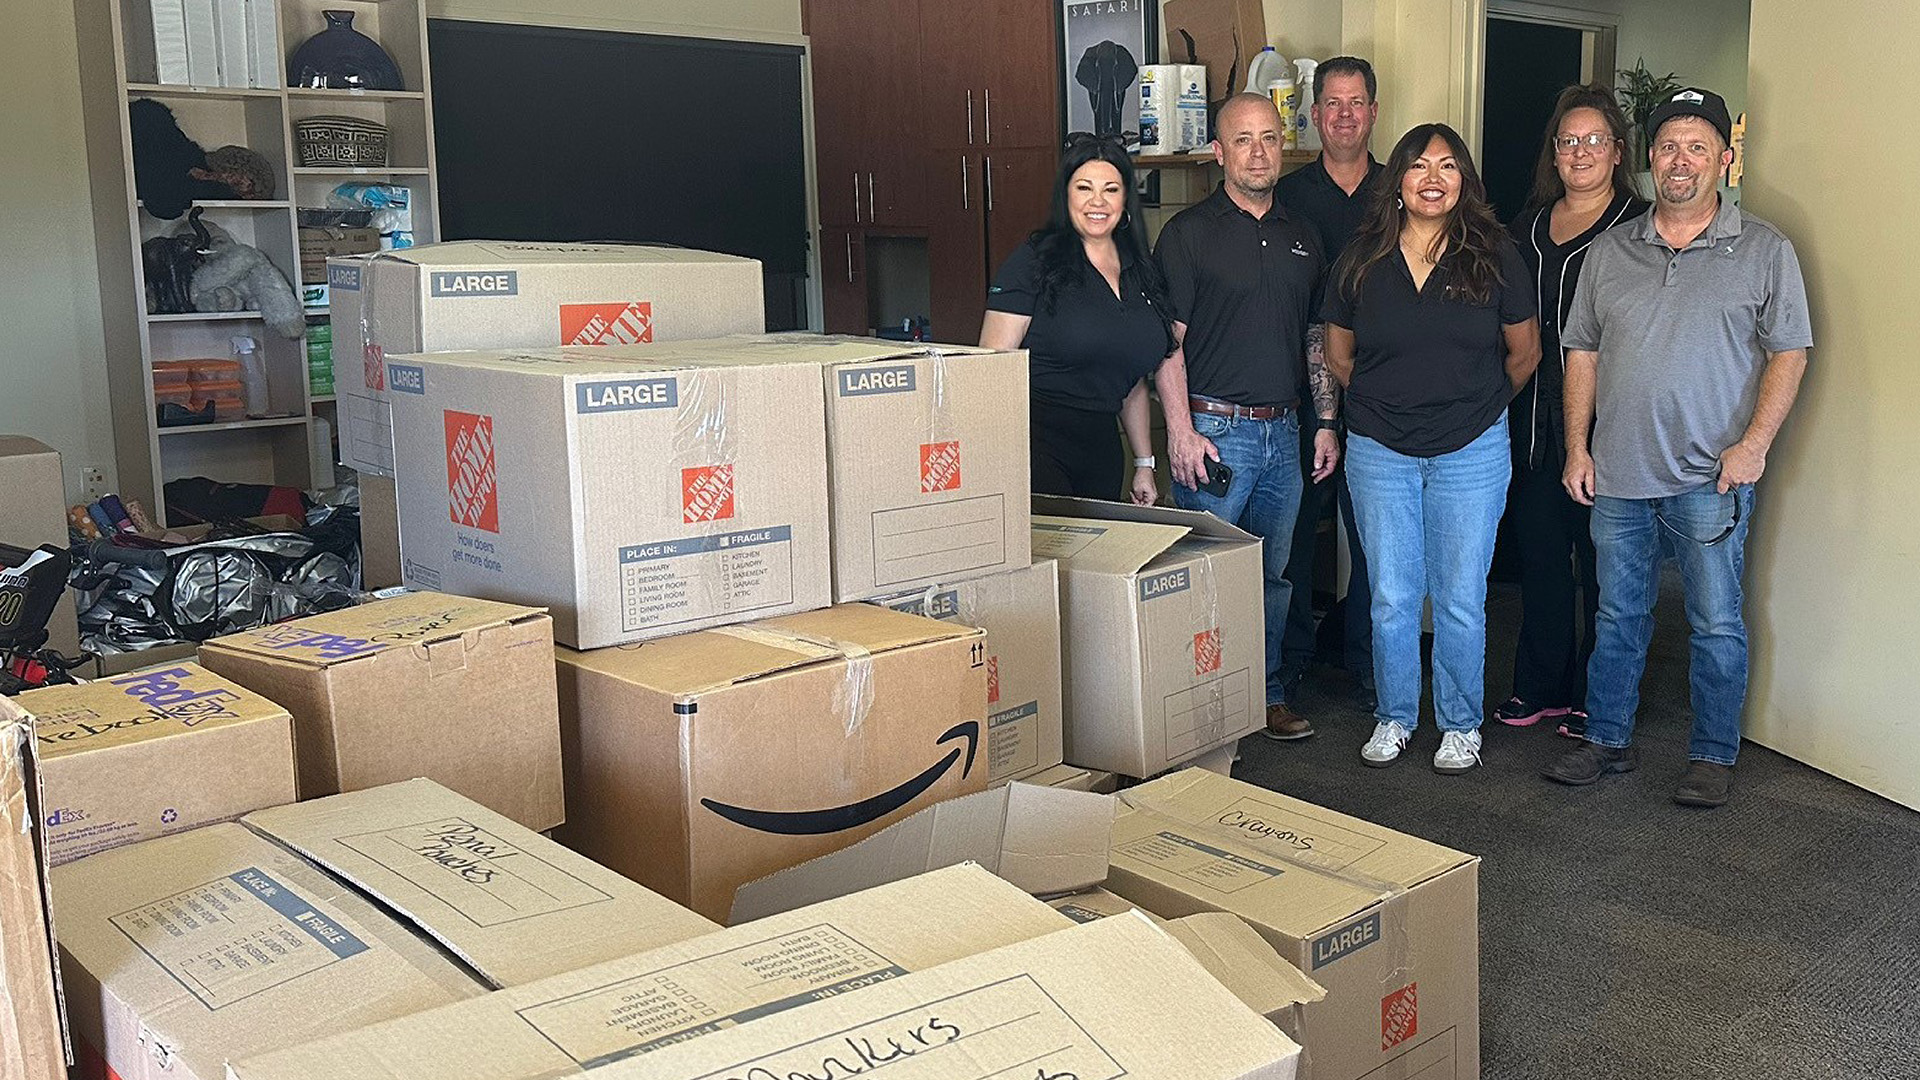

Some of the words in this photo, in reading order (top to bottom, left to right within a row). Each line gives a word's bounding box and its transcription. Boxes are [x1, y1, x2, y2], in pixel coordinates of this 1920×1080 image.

[1071, 0, 1138, 17] SAFARI
[330, 269, 357, 286] LARGE
[439, 275, 509, 292] LARGE
[391, 369, 421, 388] LARGE
[846, 370, 909, 391] LARGE
[586, 383, 668, 408] LARGE
[450, 424, 470, 468] THE
[450, 415, 494, 523] HOME
[921, 442, 959, 491] HOME
[937, 459, 960, 490] DEPOT
[683, 464, 733, 522] HOME
[687, 473, 708, 496] THE
[704, 485, 733, 520] DEPOT
[457, 531, 474, 547] How
[474, 535, 494, 553] doers
[731, 532, 771, 544] FRAGILE
[452, 549, 463, 562] get
[464, 553, 483, 567] more
[626, 546, 660, 559] PLACE
[663, 544, 677, 553] IN:
[731, 551, 761, 560] KITCHEN
[638, 564, 670, 574] PRIMARY
[732, 560, 763, 570] LAUNDRY
[733, 568, 768, 579] BASEMENT
[638, 573, 675, 584] BEDROOM
[639, 584, 664, 594] FAMILY
[665, 581, 687, 589] ROOM
[733, 580, 760, 589] GARAGE
[1144, 572, 1185, 595] LARGE
[640, 594, 663, 604] LIVING
[664, 590, 685, 600] ROOM
[733, 589, 751, 599] ATTIC
[640, 604, 665, 614] DINING
[666, 600, 688, 609] ROOM
[640, 615, 659, 624] BATH
[110, 667, 241, 727] FedEx
[46, 808, 84, 827] dEx
[1218, 811, 1314, 851] Crayons
[423, 824, 519, 859] Pencil
[416, 839, 500, 884] Pouches
[239, 873, 269, 891] PLACE
[305, 917, 346, 944] FRAGILE
[780, 935, 811, 947] BATH
[780, 941, 820, 956] DINING
[1318, 920, 1374, 962] LARGE
[741, 952, 779, 967] ROOM
[794, 948, 830, 961] LIVING
[800, 954, 841, 968] FAMILY
[754, 958, 792, 972] ROOM
[760, 965, 798, 980] ROOM
[789, 959, 850, 980] BEDROOM
[809, 966, 860, 984] PRIMARY
[839, 971, 896, 991] PLACE
[621, 988, 657, 1003] ATTIC
[611, 995, 667, 1015] GARAGE
[605, 1001, 678, 1028] BASEMENT
[625, 1008, 687, 1031] LAUNDRY
[637, 1015, 696, 1037] KITCHEN
[628, 1026, 712, 1056] FRAGILE
